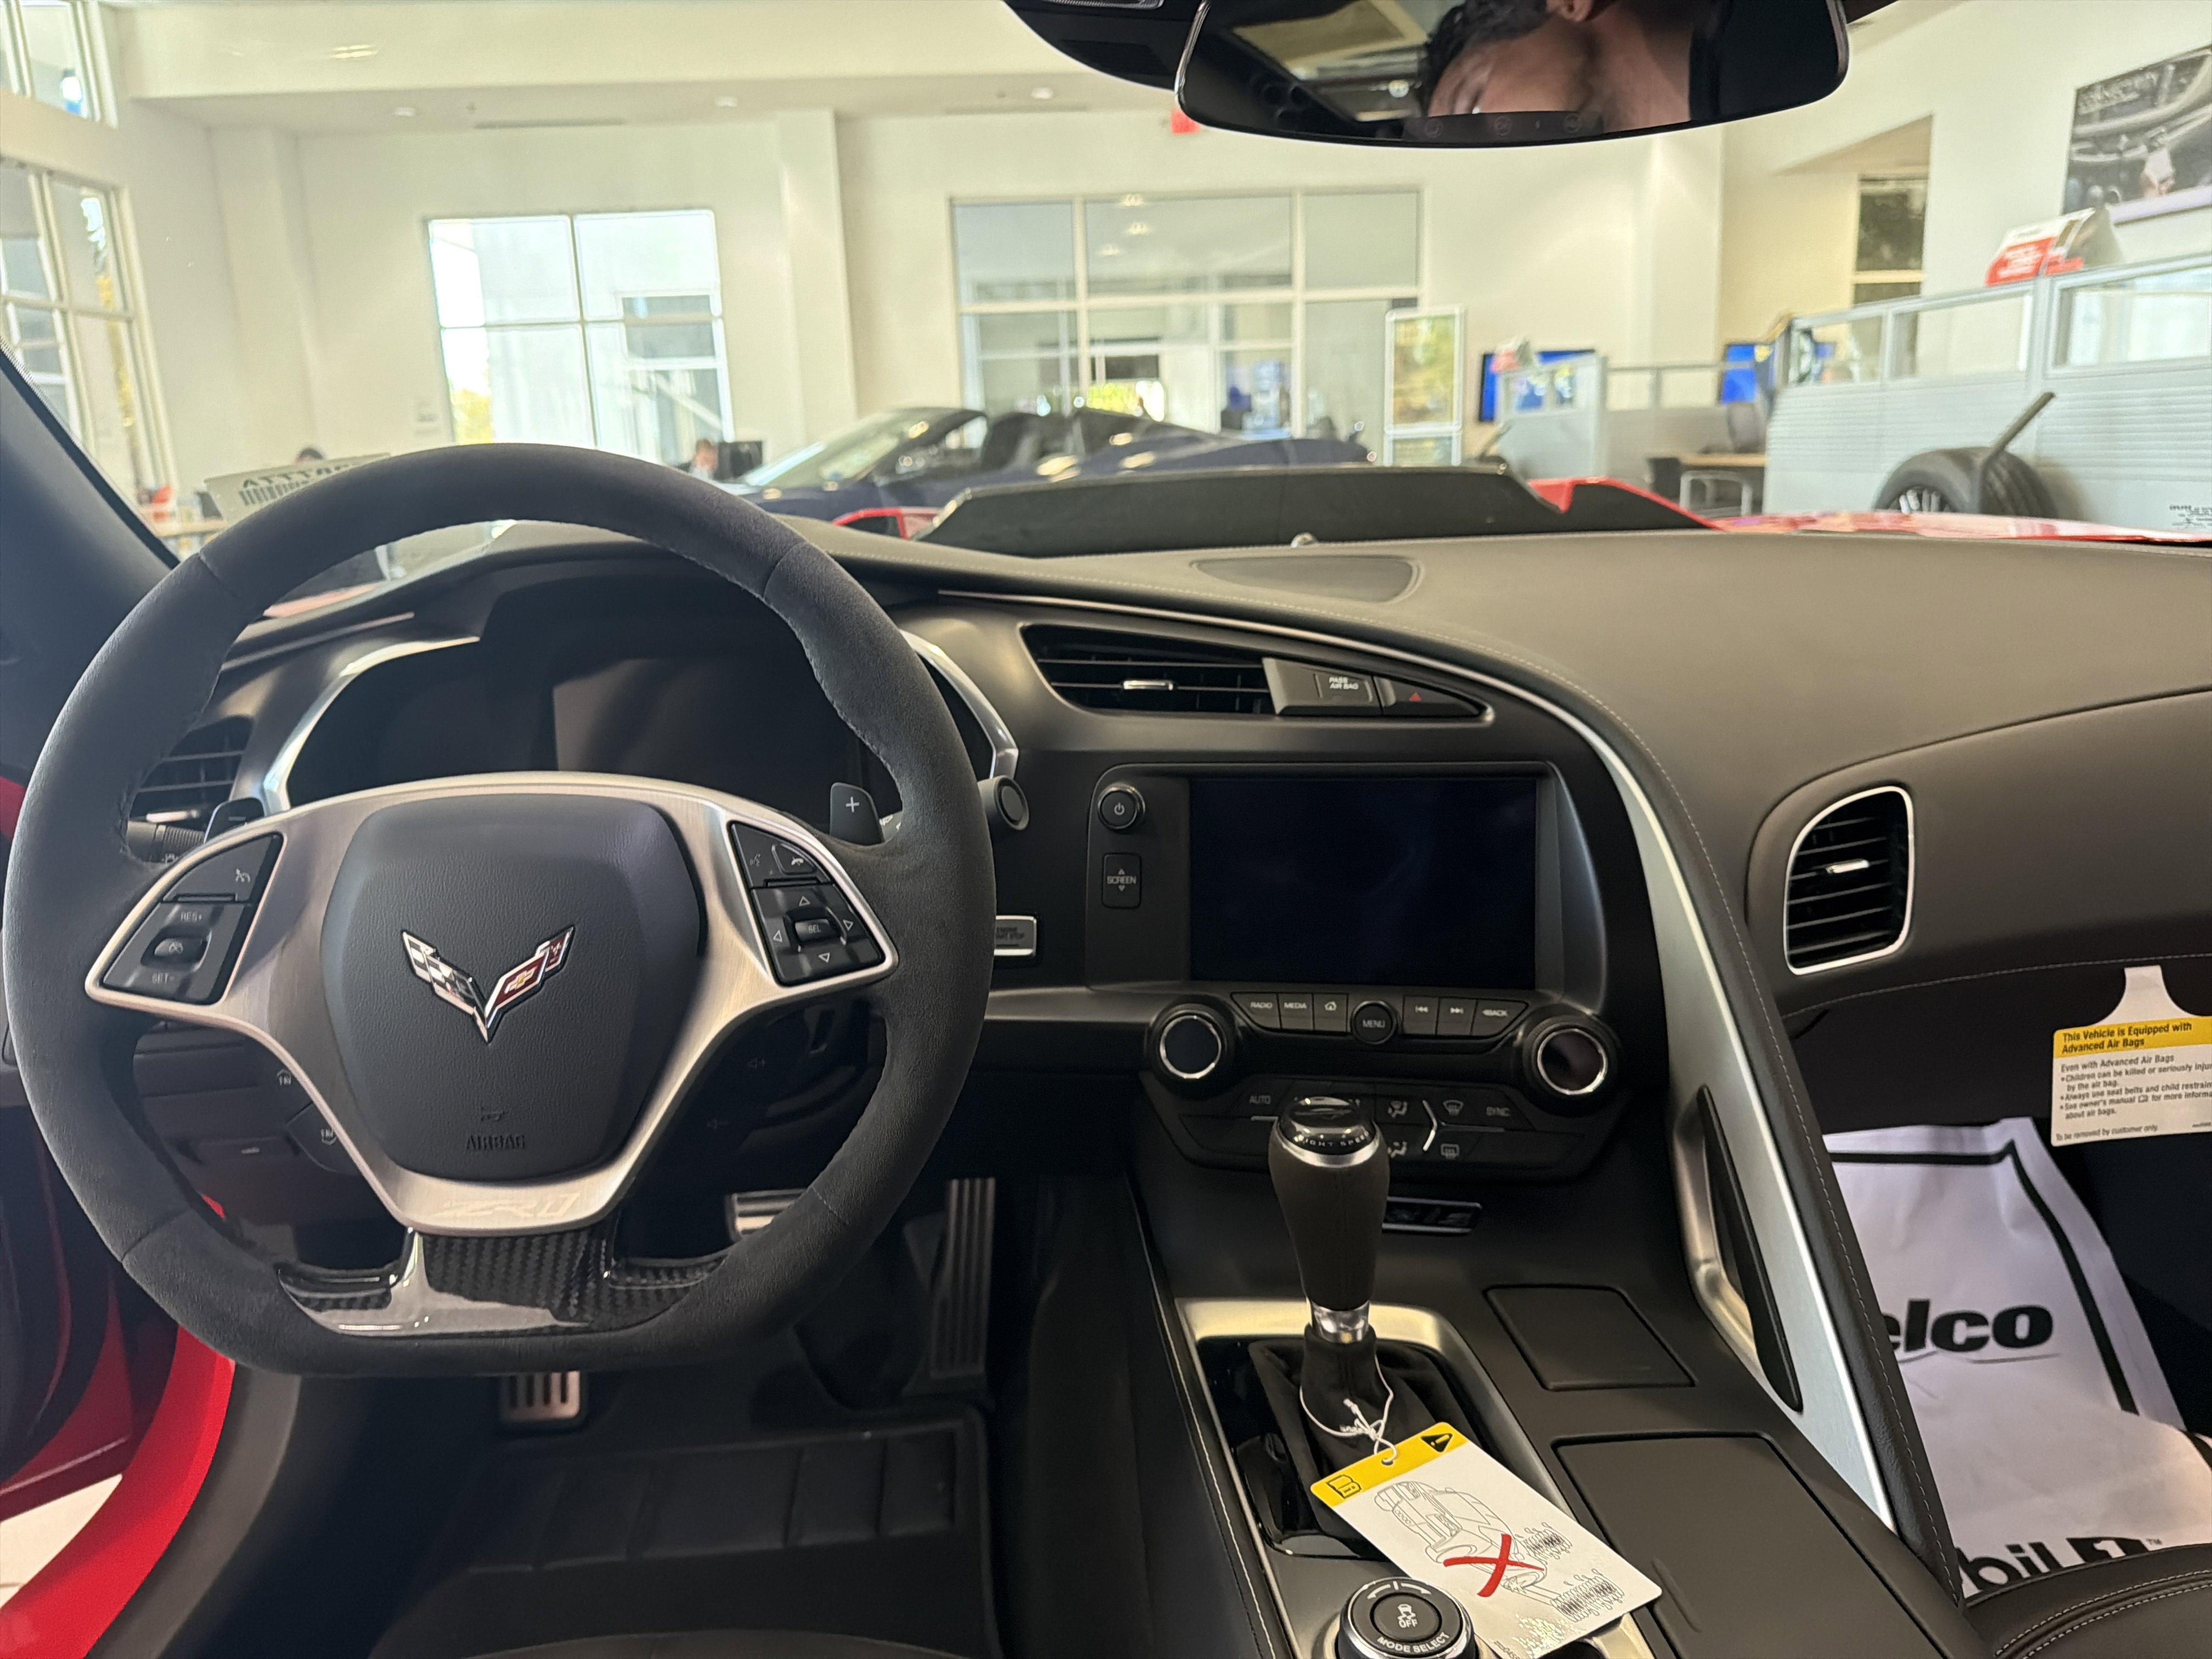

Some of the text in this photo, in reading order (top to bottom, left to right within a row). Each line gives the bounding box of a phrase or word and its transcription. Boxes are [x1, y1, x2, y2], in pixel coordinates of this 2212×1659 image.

[1107, 876, 1137, 884] SCREEN
[808, 924, 821, 934] SEL
[1362, 1019, 1385, 1029] MENU
[2063, 1022, 2192, 1043] This Vehicle is Equipped with
[2062, 1038, 2145, 1054] Advanced Air Bags
[2061, 1054, 2174, 1073] Even with Advanced Air Bags
[2066, 1073, 2096, 1082] Children
[2125, 1067, 2146, 1075] killed
[2158, 1064, 2193, 1073] seriously
[2064, 1092, 2090, 1101] Always
[2107, 1088, 2123, 1096] seat
[2124, 1086, 2143, 1095] belts
[2145, 1085, 2159, 1093] and
[2161, 1082, 2180, 1092] child
[2067, 1084, 2075, 1092] by
[2091, 1081, 2101, 1089] air
[2103, 1080, 2118, 1088] bag.
[1249, 1095, 1271, 1104] AUTO
[2064, 1102, 2078, 1110] See
[2079, 1099, 2107, 1109] owner's
[2108, 1096, 2136, 1105] manual
[1486, 1106, 1511, 1117] SYNC
[2065, 1108, 2117, 1120] about air bags.
[1340, 1130, 1369, 1146] SPEED
[2056, 1133, 2063, 1141] To
[2073, 1128, 2101, 1139] removed
[2102, 1128, 2110, 1136] by
[2111, 1126, 2143, 1136] customer
[466, 1134, 527, 1151] AIRBAG
[1398, 1618, 1418, 1628] OFF
[1377, 1632, 1450, 1654] MODE SELECT
